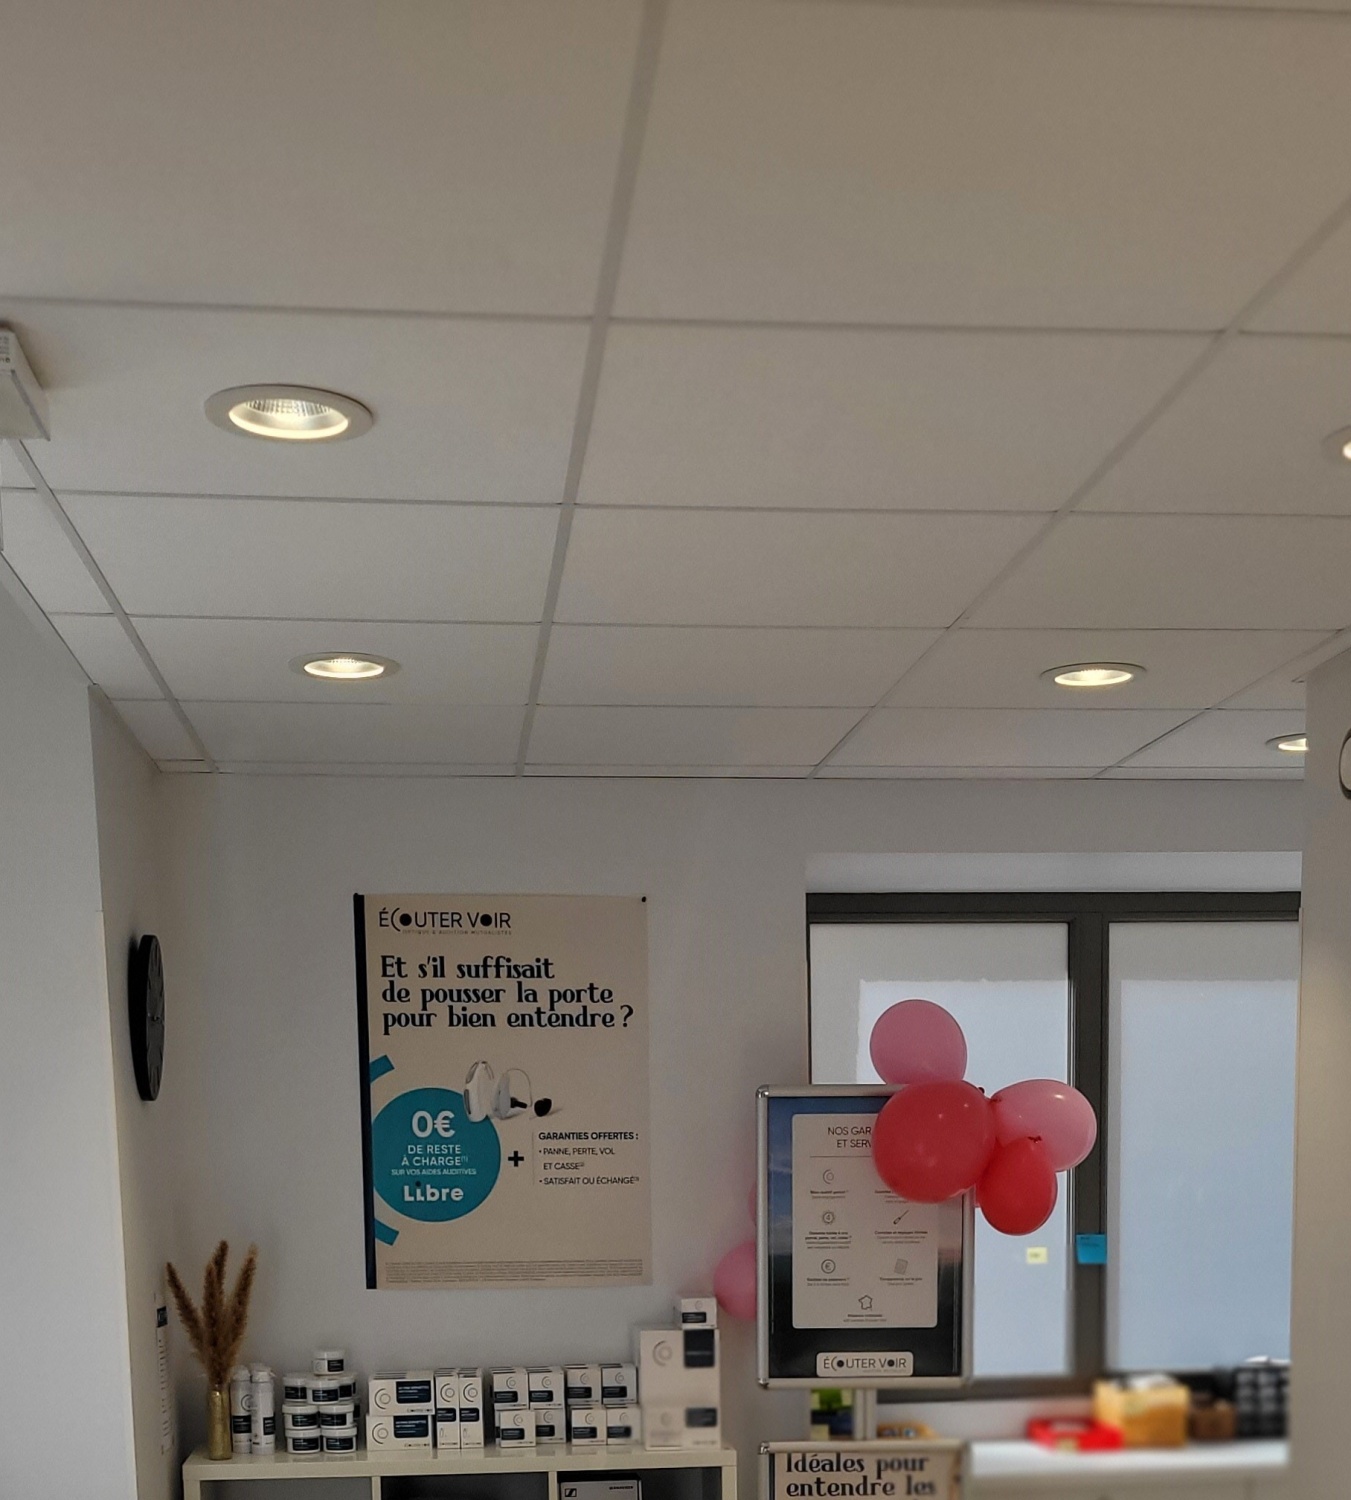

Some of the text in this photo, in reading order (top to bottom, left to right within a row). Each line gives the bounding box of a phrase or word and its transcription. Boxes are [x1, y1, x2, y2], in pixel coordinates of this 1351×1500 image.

[467, 912, 512, 928] VOIR
[381, 955, 555, 979] Et s'il suffisait
[382, 980, 613, 1012] de pousser la porte
[383, 1010, 437, 1036] pour
[448, 1006, 496, 1028] bien
[507, 1006, 615, 1028] entendre
[412, 1110, 456, 1138] 0€
[538, 1132, 588, 1140] GARANTIES
[590, 1132, 634, 1140] OFFERTES
[828, 1126, 848, 1136] NOS
[408, 1145, 462, 1154] DE RESTE
[836, 1140, 848, 1148] ET
[543, 1148, 571, 1156] PANNE,
[572, 1148, 598, 1156] PERTE,
[544, 1162, 552, 1170] ET
[544, 1177, 580, 1185] SATISFAIT
[404, 1180, 464, 1202] Libre
[878, 1358, 906, 1368] VOIR
[786, 1453, 928, 1480] Idéales pour
[786, 1475, 936, 1497] entendre les
